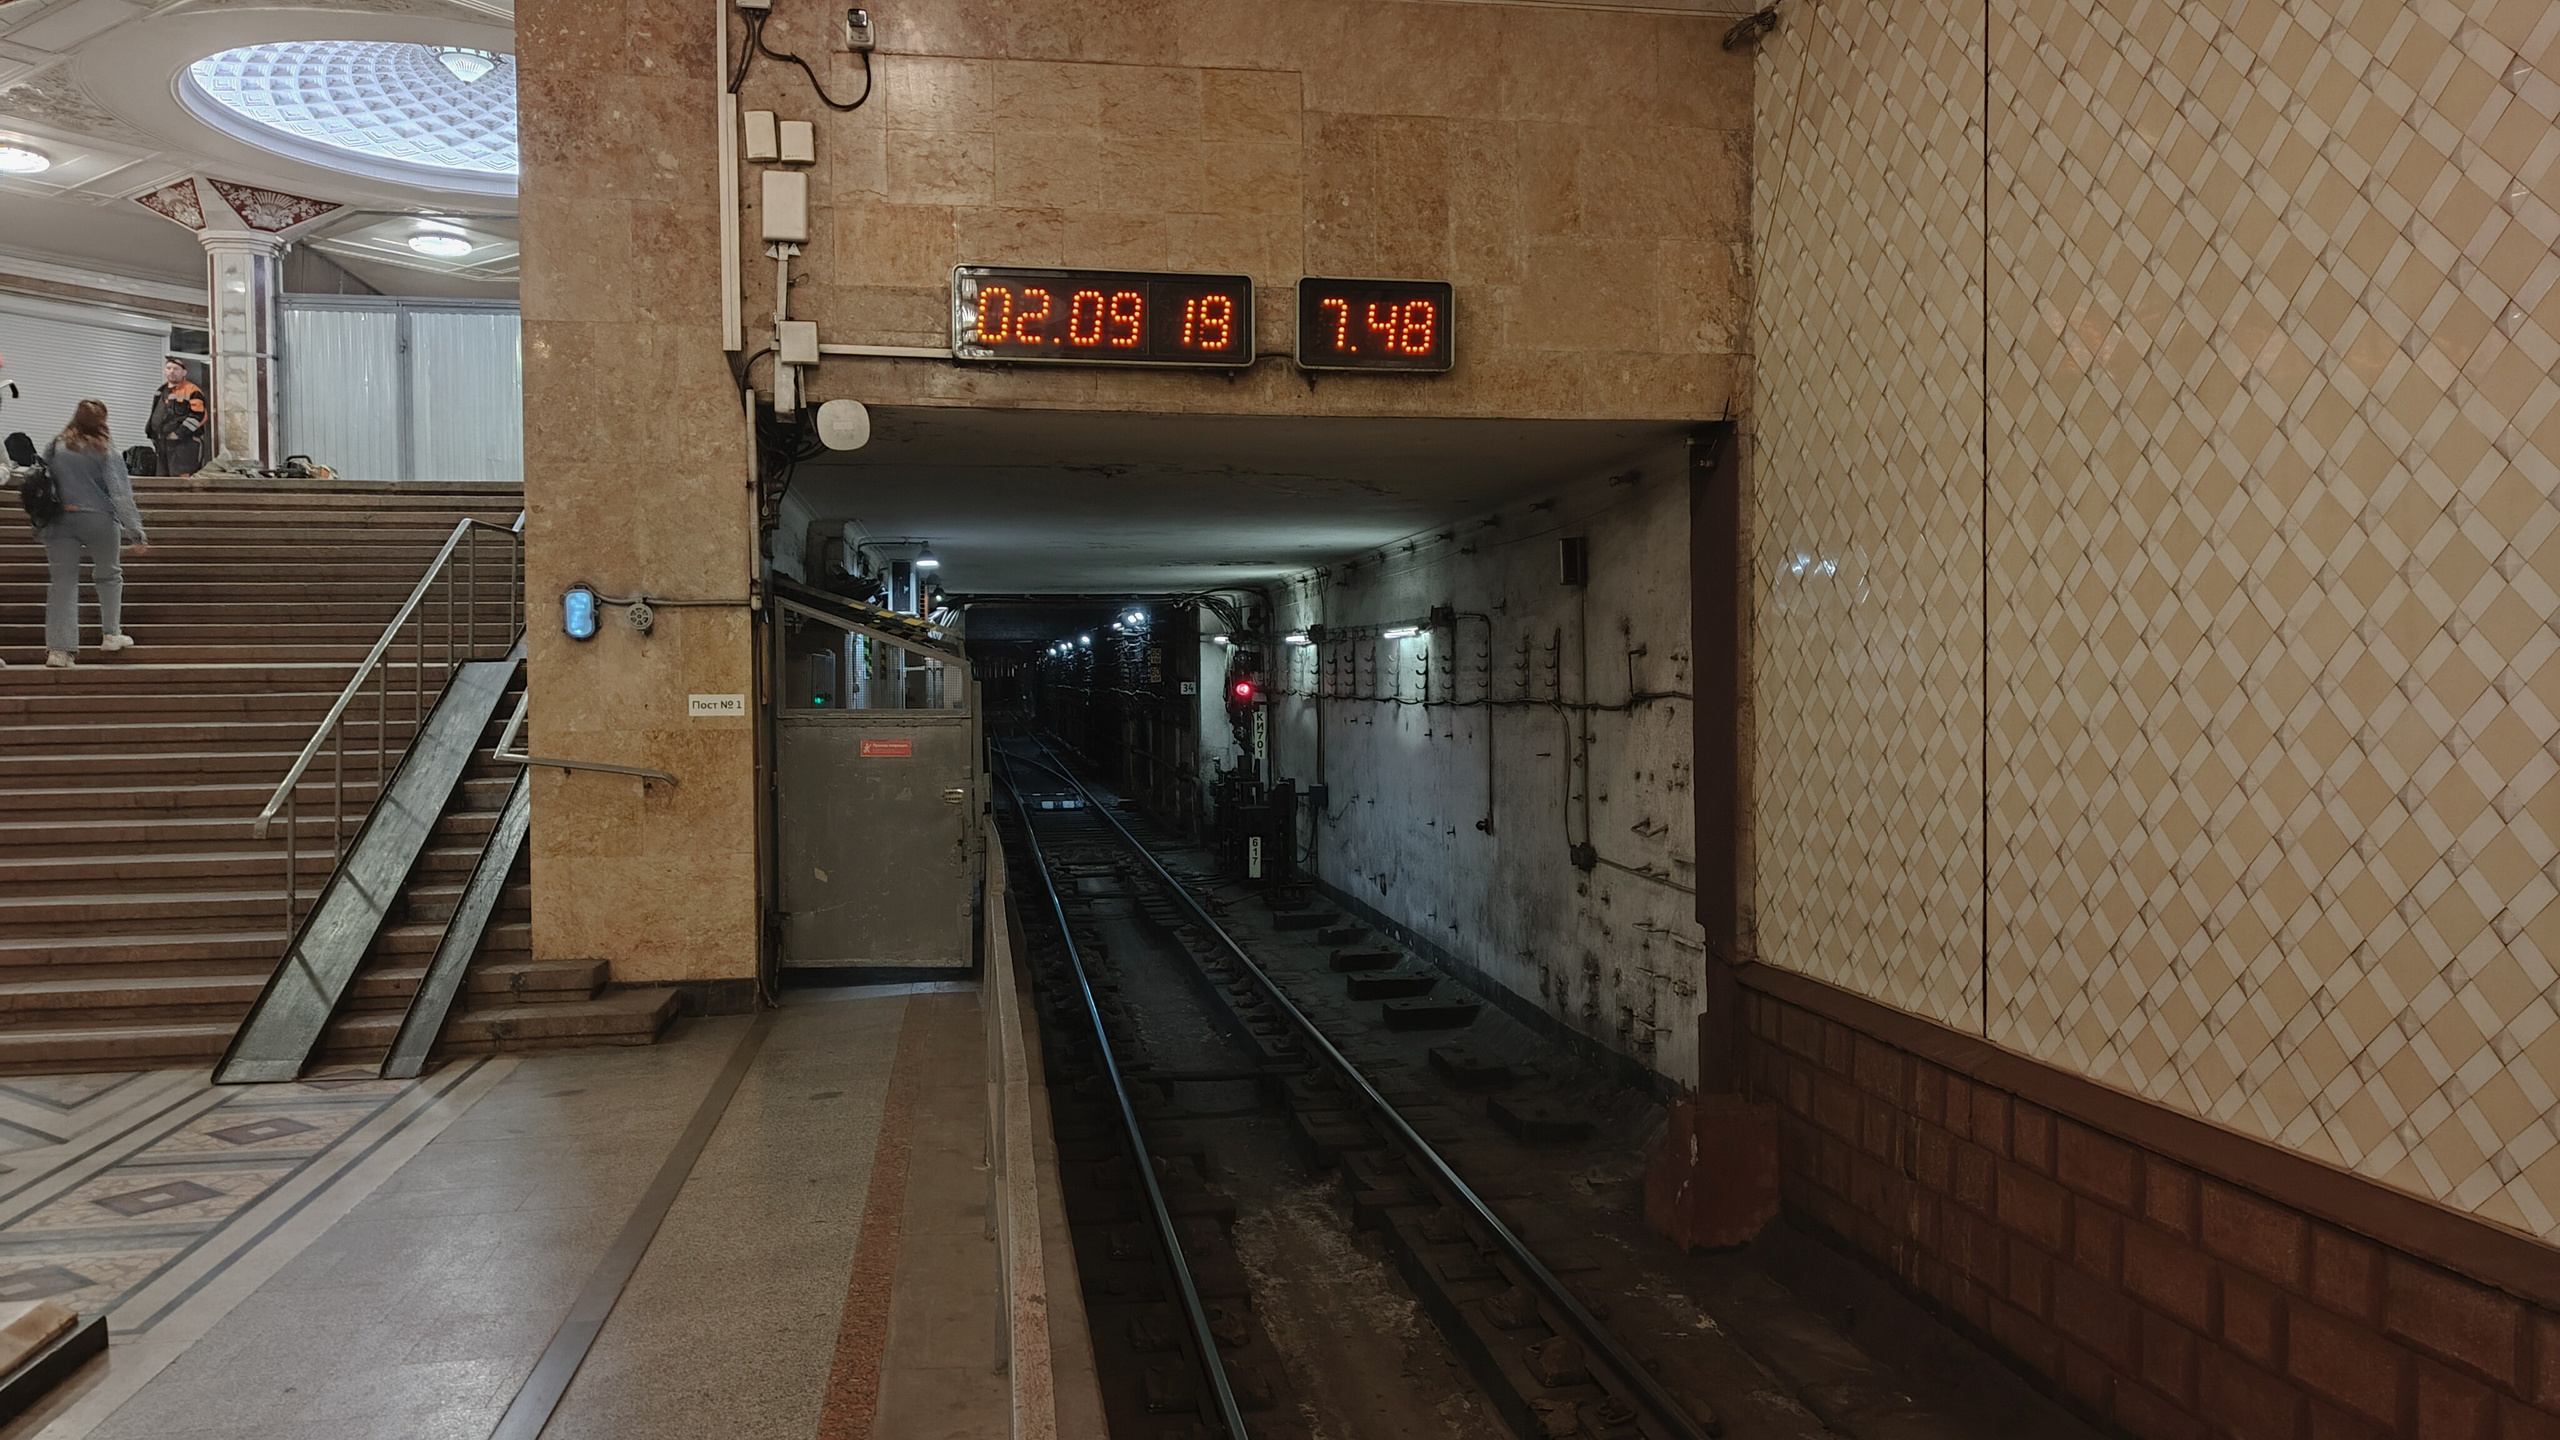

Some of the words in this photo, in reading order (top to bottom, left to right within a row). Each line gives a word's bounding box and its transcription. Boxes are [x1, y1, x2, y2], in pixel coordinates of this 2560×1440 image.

[975, 286, 1143, 345] 02.09
[1320, 297, 1436, 354] 7.48
[692, 700, 718, 710] Пост
[736, 700, 742, 710] 1
[1182, 683, 1194, 693] 34
[1256, 713, 1264, 758] КИ701
